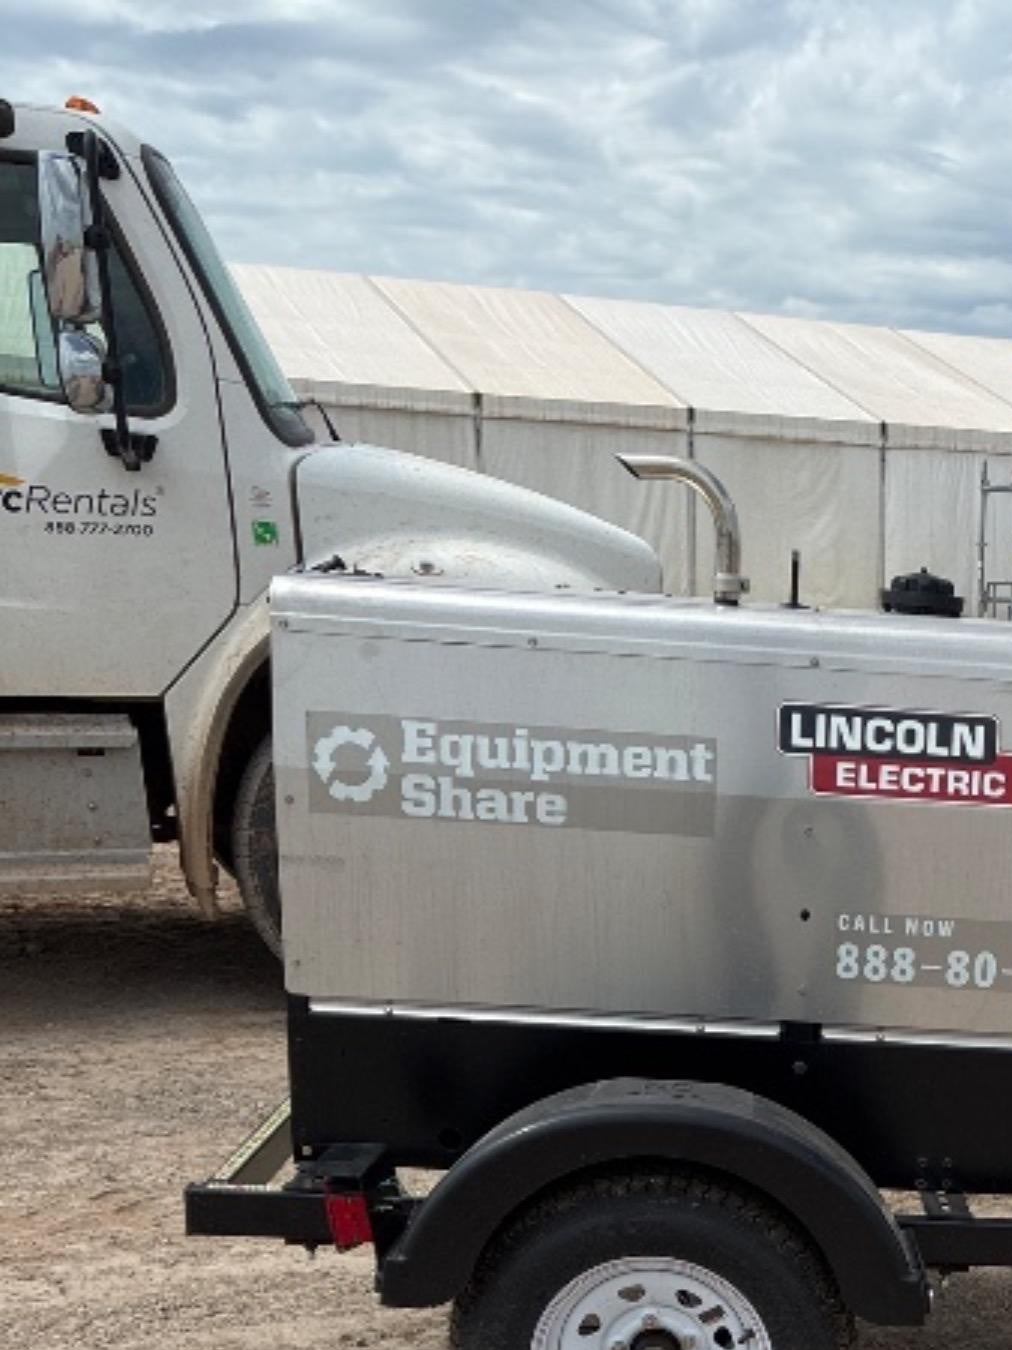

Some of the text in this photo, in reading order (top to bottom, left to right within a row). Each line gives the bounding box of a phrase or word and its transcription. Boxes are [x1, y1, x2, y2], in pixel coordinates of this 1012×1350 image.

[0, 485, 157, 517] cRentals
[400, 718, 713, 783] Equipment
[790, 712, 986, 760] LINCOLN
[400, 773, 568, 826] Share
[835, 761, 1006, 798] ELECTRIC
[837, 913, 956, 938] CALL NOW
